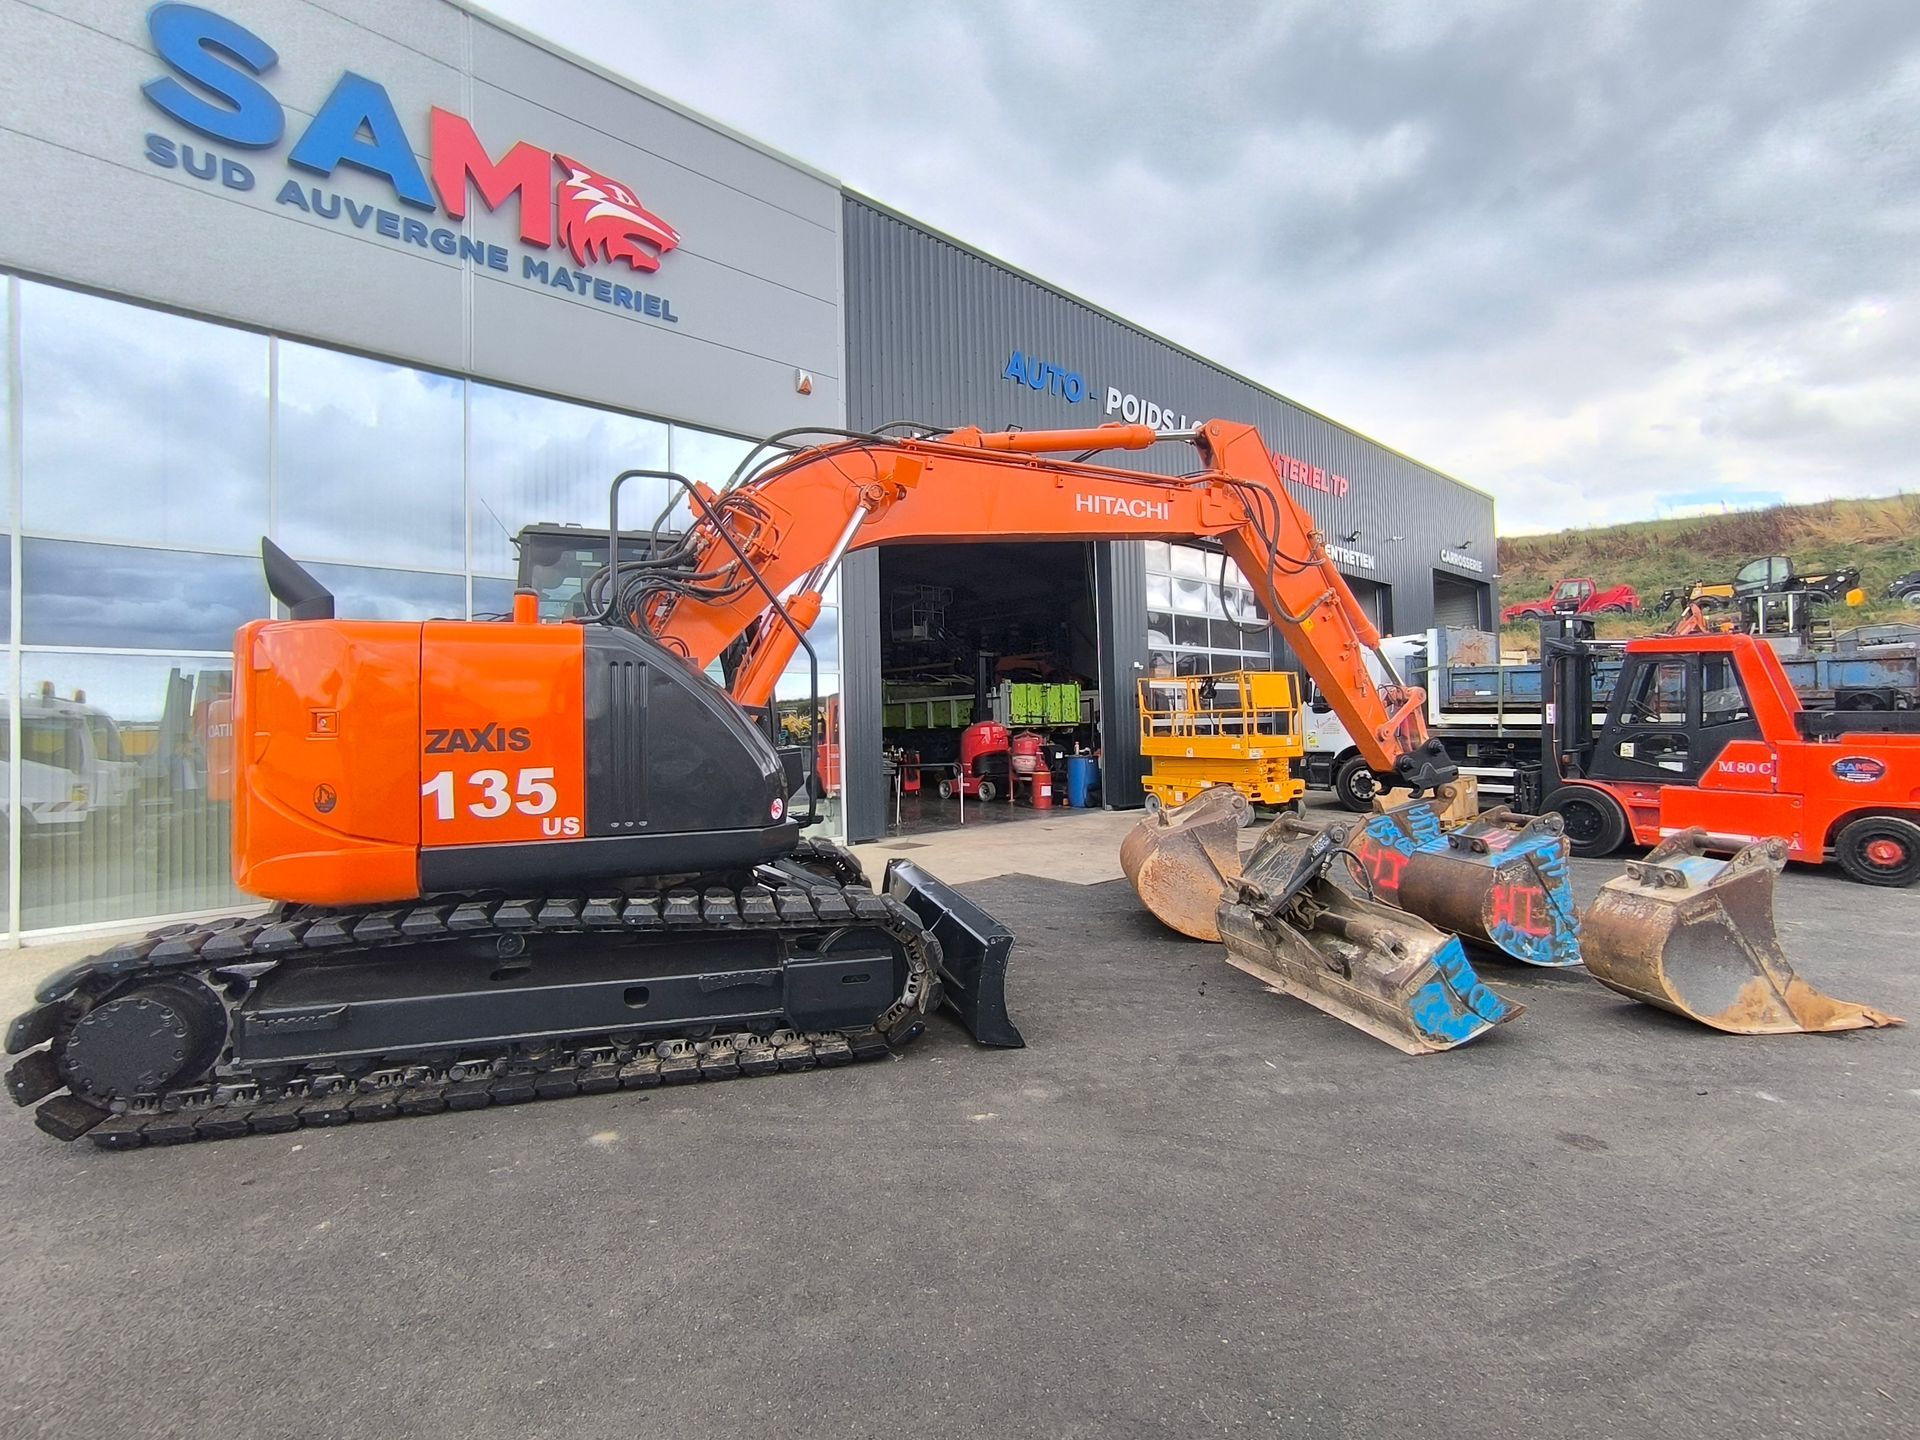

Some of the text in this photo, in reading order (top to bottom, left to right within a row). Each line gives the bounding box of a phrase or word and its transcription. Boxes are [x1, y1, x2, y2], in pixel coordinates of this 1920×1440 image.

[140, 1, 552, 250] SAM
[143, 132, 680, 324] SUD AUVERGNE MATERIEL
[1003, 351, 1086, 404] AUTO
[1106, 386, 1174, 432] POIDS
[1271, 451, 1348, 499] ATERIEL TP
[1075, 493, 1170, 521] HITACHI
[1325, 543, 1375, 570] ENTRETIEN
[424, 721, 532, 755] ZAXIS
[421, 766, 558, 822] 135
[542, 816, 581, 836] US
